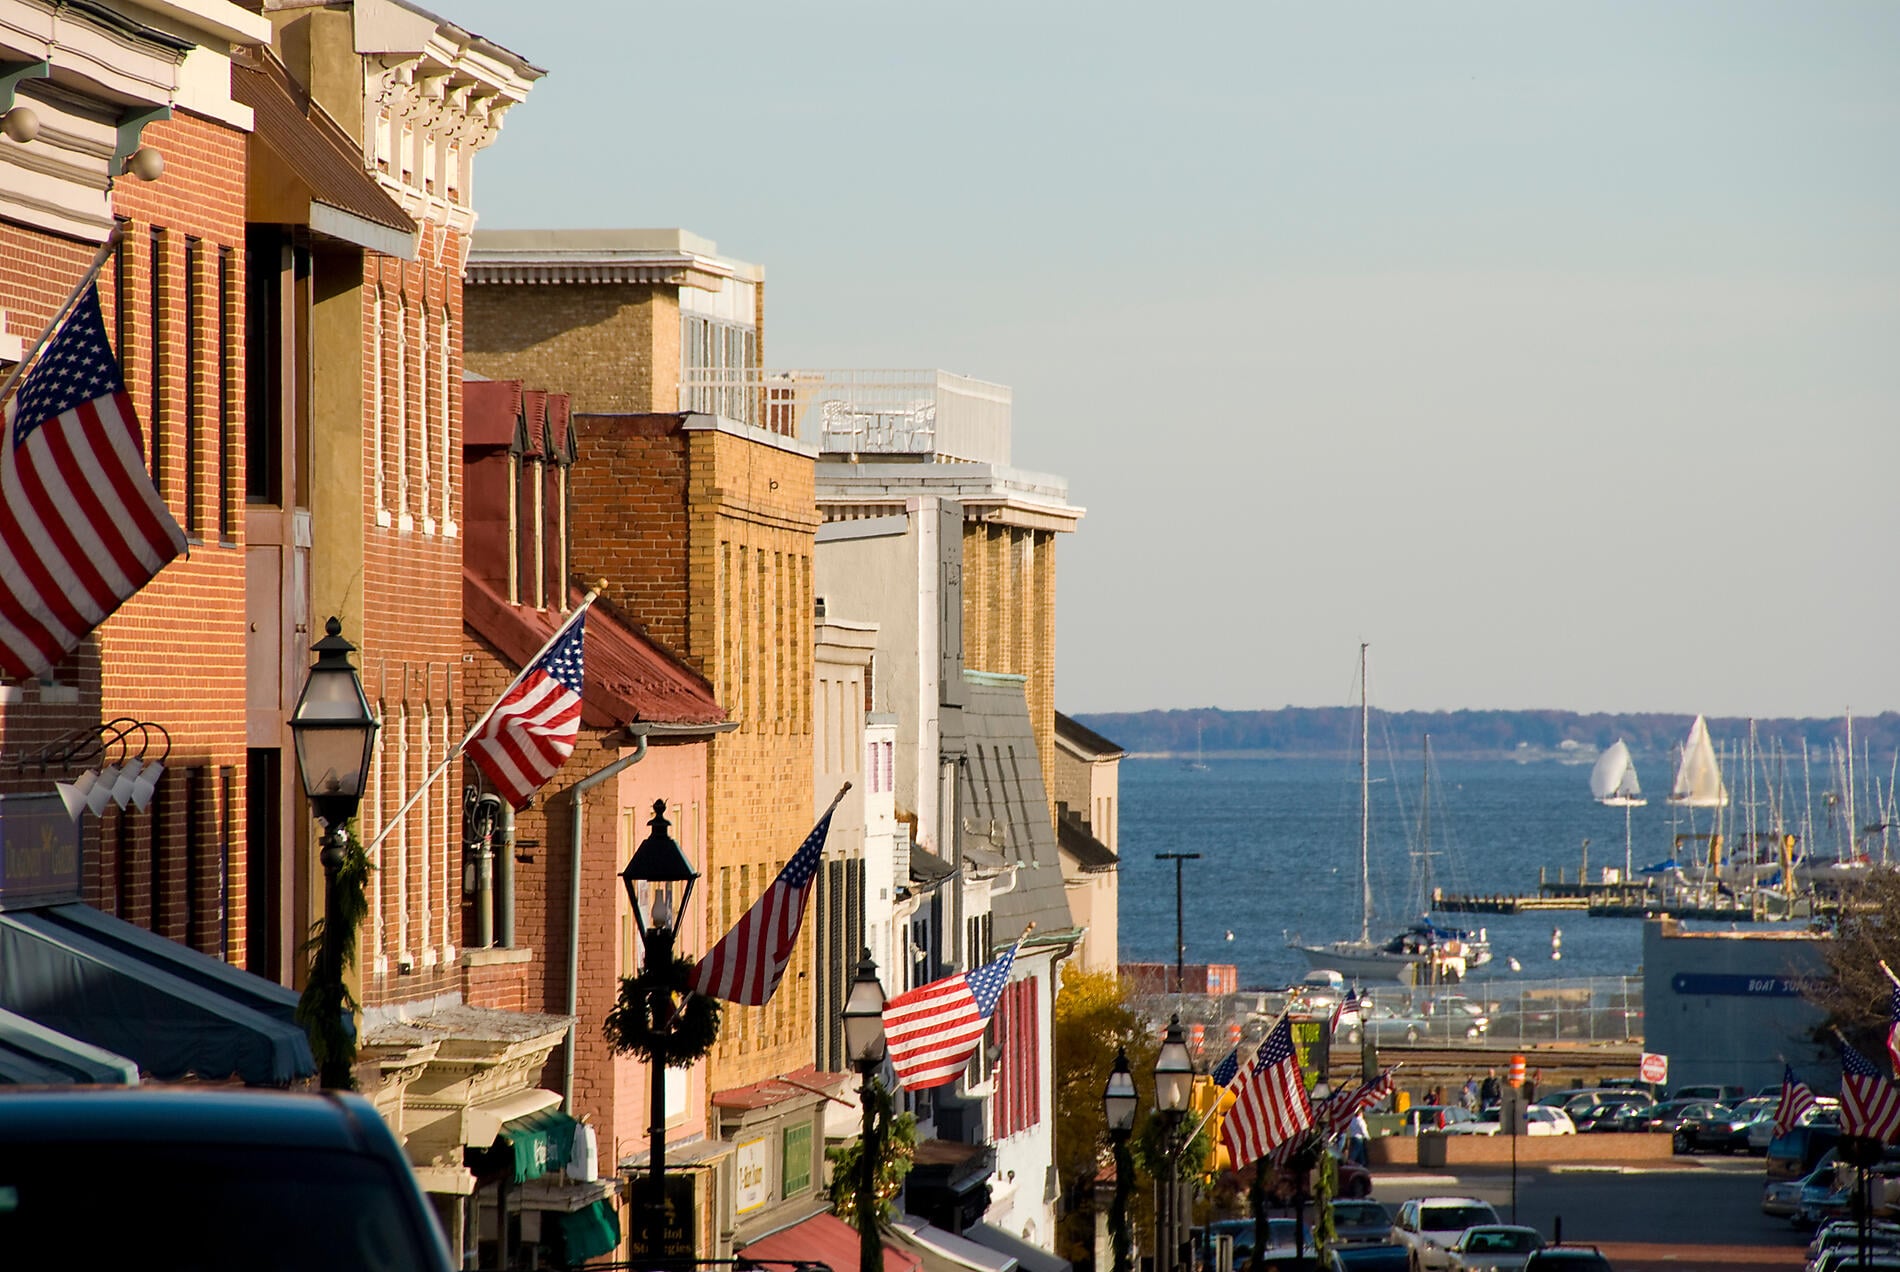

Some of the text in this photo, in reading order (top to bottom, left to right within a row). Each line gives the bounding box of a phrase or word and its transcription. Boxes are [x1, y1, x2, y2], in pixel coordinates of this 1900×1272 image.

[1748, 979, 1776, 992] BOAT
[641, 1227, 683, 1240] Citol
[632, 1241, 692, 1256] Stgies
